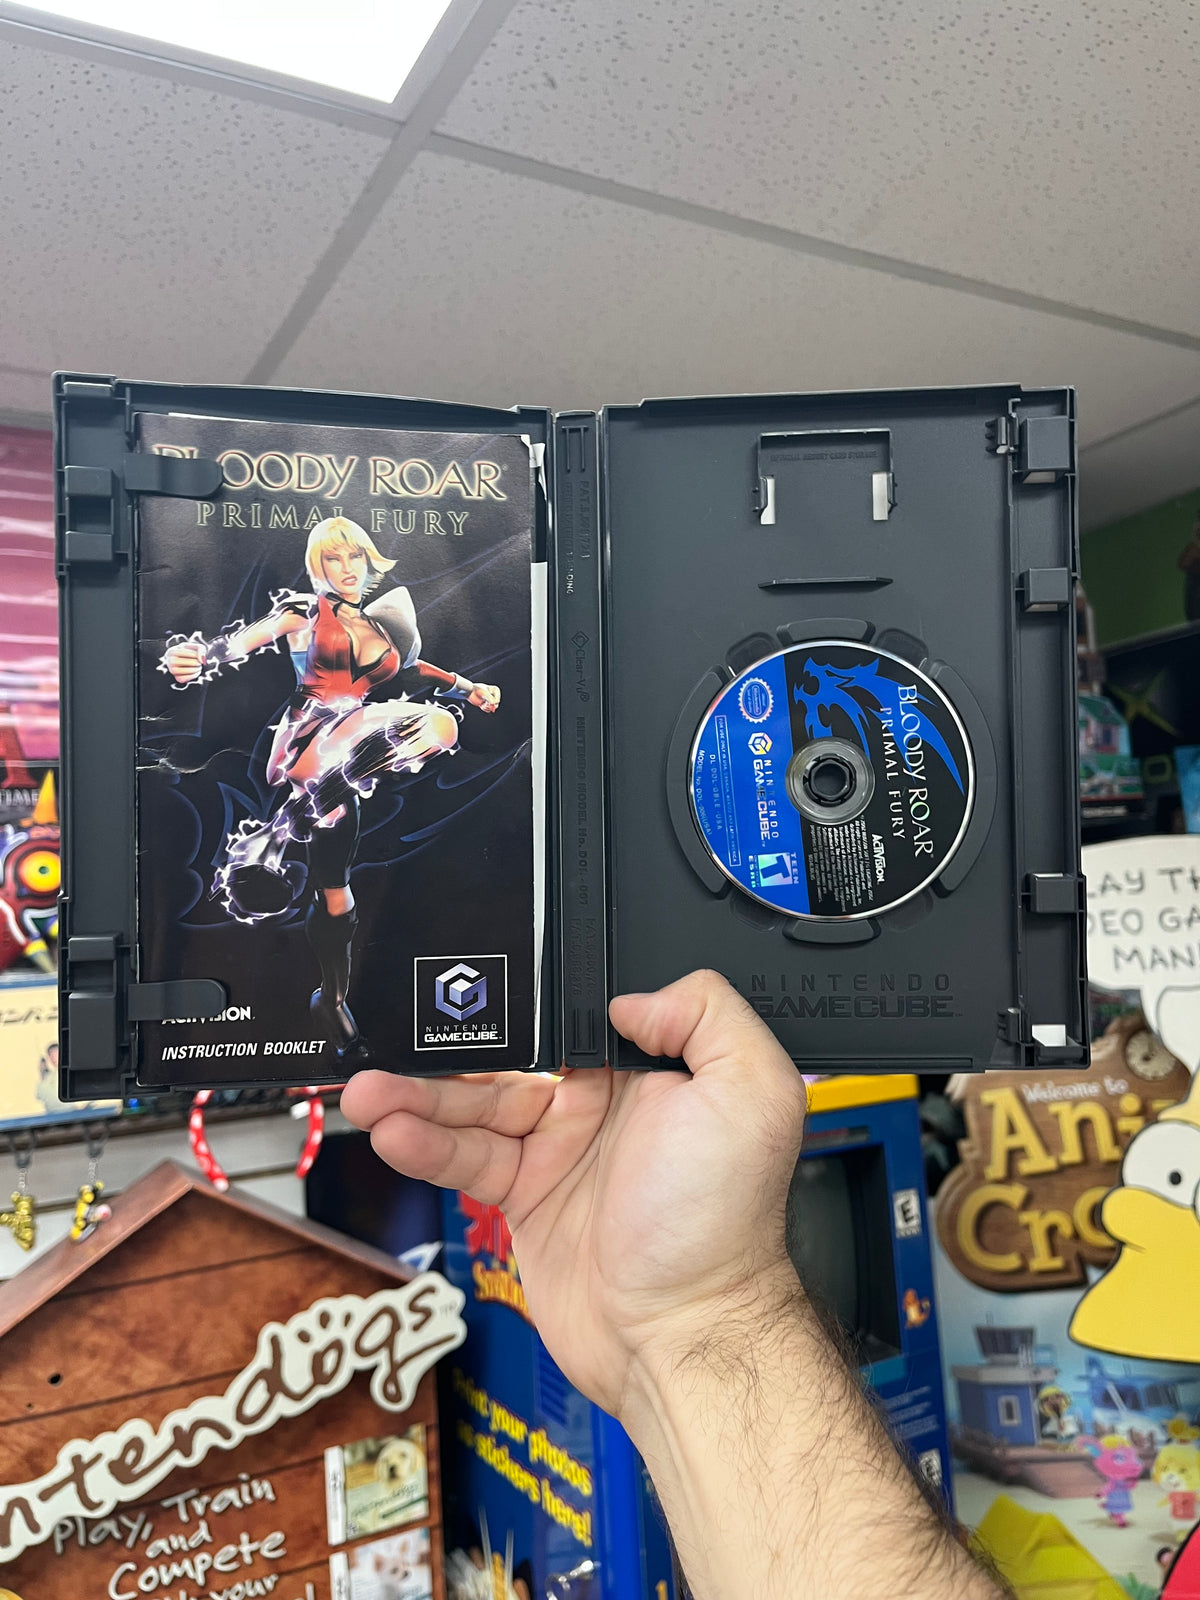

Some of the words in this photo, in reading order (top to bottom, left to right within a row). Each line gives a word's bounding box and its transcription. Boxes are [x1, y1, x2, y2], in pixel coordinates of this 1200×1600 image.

[370, 460, 505, 499] ROAR
[371, 508, 469, 536] FURY
[898, 685, 926, 780] BLOODY
[880, 707, 898, 780] PRIMAL
[889, 791, 905, 839] FURY
[753, 759, 770, 840] GAMECUBE
[764, 760, 778, 838] NINTENDO
[908, 788, 933, 857] ROAR
[791, 852, 799, 884] TEEN
[872, 834, 885, 882] ACTIVISION
[1088, 867, 1145, 898] AY
[750, 973, 950, 992] NINTENDO
[750, 995, 954, 1018] GAMECUBE
[424, 1031, 499, 1043] GAMECUBE
[425, 1023, 497, 1033] NINTENDO
[162, 1042, 258, 1061] INSTRUCTION
[263, 1040, 327, 1056] BOOKLET
[1103, 1075, 1129, 1095] to
[979, 1087, 1176, 1180] Ani
[160, 1472, 276, 1523] Train
[145, 1520, 213, 1558] and
[108, 1531, 286, 1600] Compete
